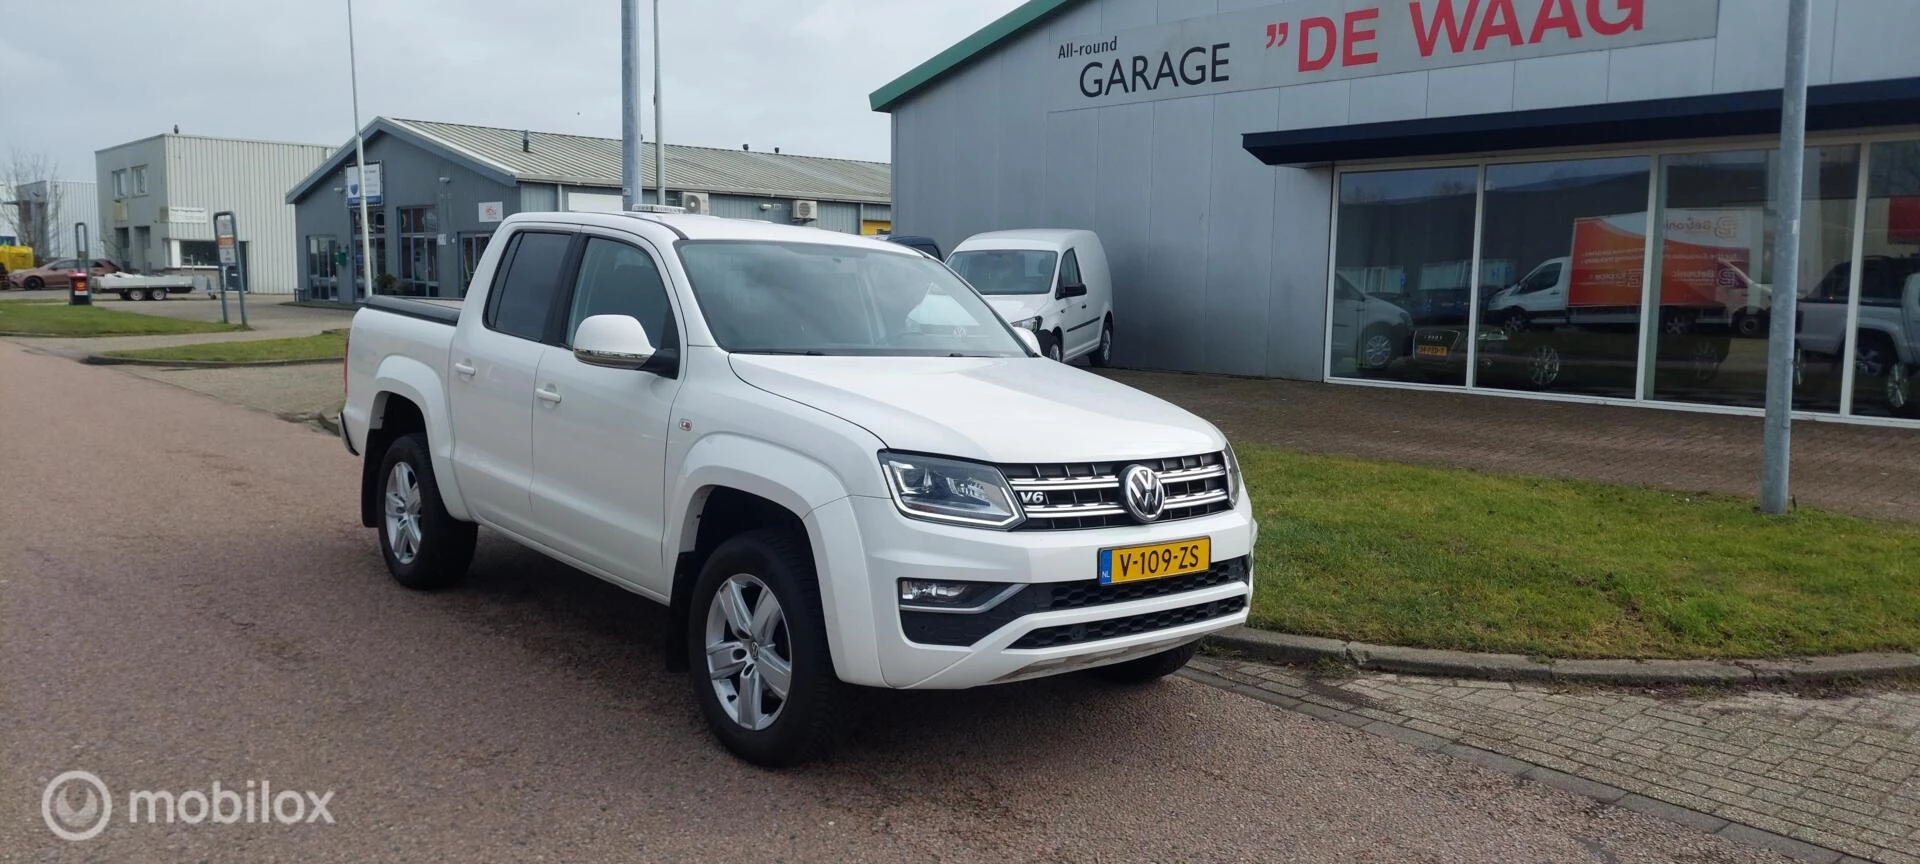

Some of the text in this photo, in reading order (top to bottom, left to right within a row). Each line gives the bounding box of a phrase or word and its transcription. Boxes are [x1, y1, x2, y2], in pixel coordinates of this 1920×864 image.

[1057, 36, 1118, 59] All-round
[1079, 42, 1231, 98] GARAGE
[1410, 0, 1644, 57] WAAG
[1020, 491, 1044, 504] V6
[1119, 545, 1199, 577] V-109-ZS
